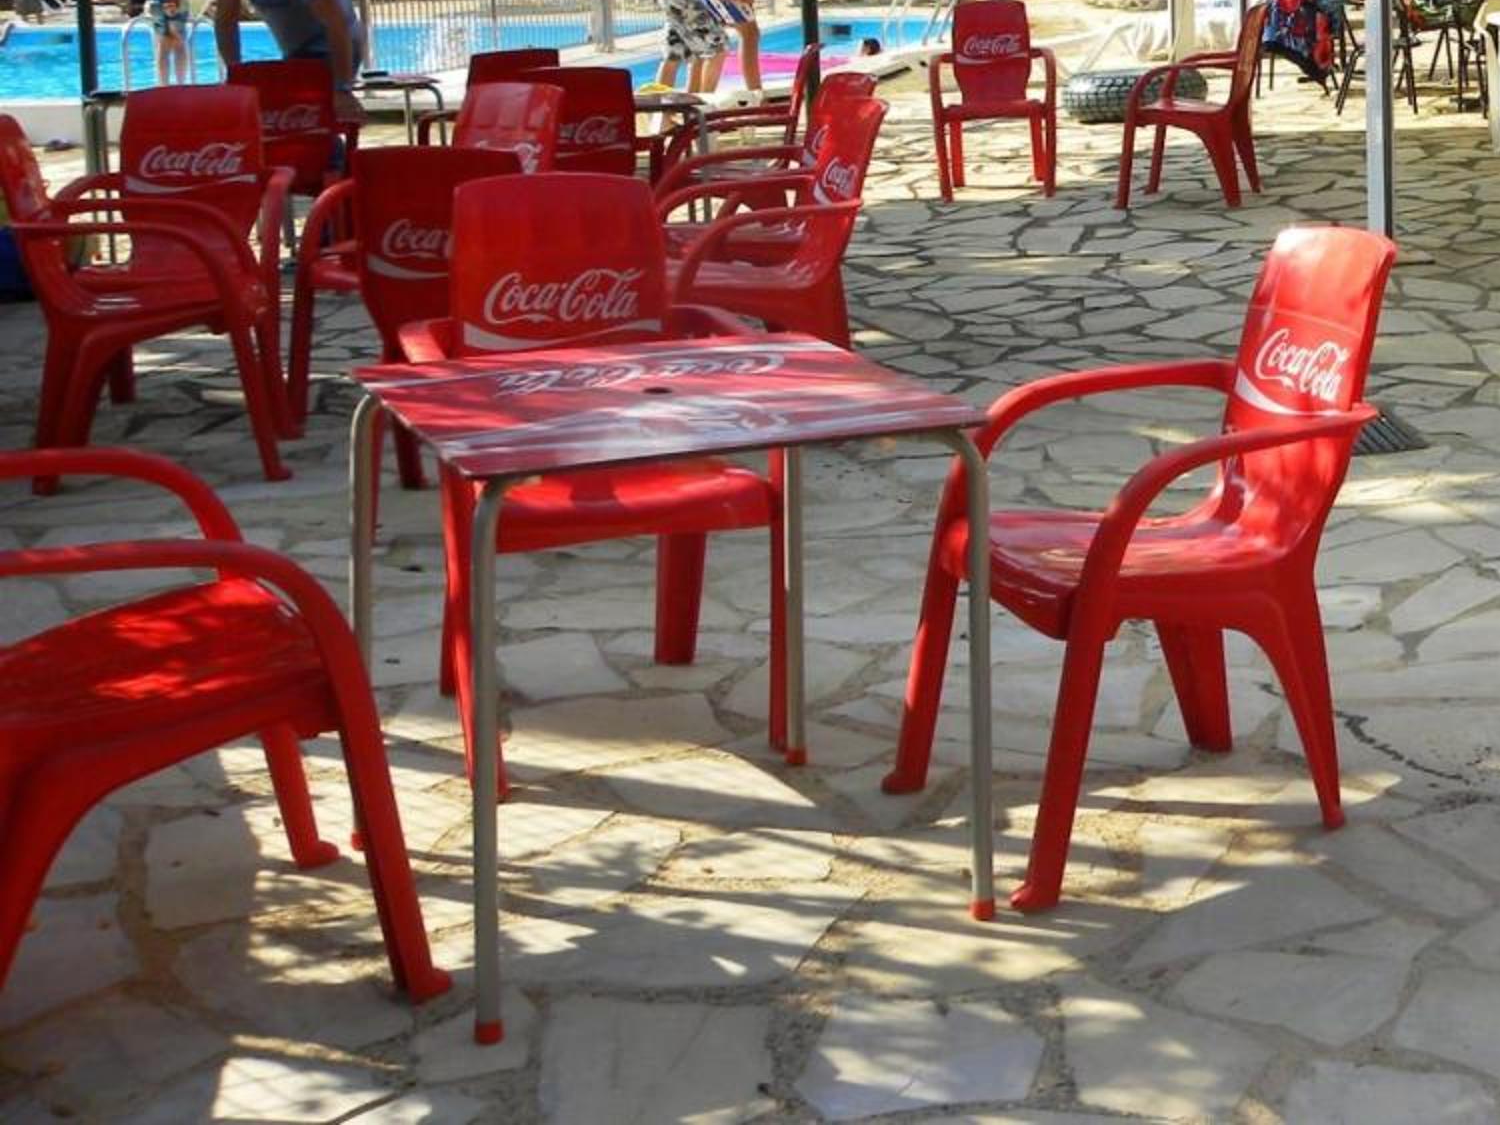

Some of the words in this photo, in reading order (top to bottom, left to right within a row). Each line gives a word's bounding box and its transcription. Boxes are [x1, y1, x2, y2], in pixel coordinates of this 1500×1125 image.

[139, 142, 248, 177] Coca-Cola
[382, 218, 454, 258] Coca-
[483, 268, 647, 325] Coca-Cola
[1255, 328, 1349, 403] Coca-Cola
